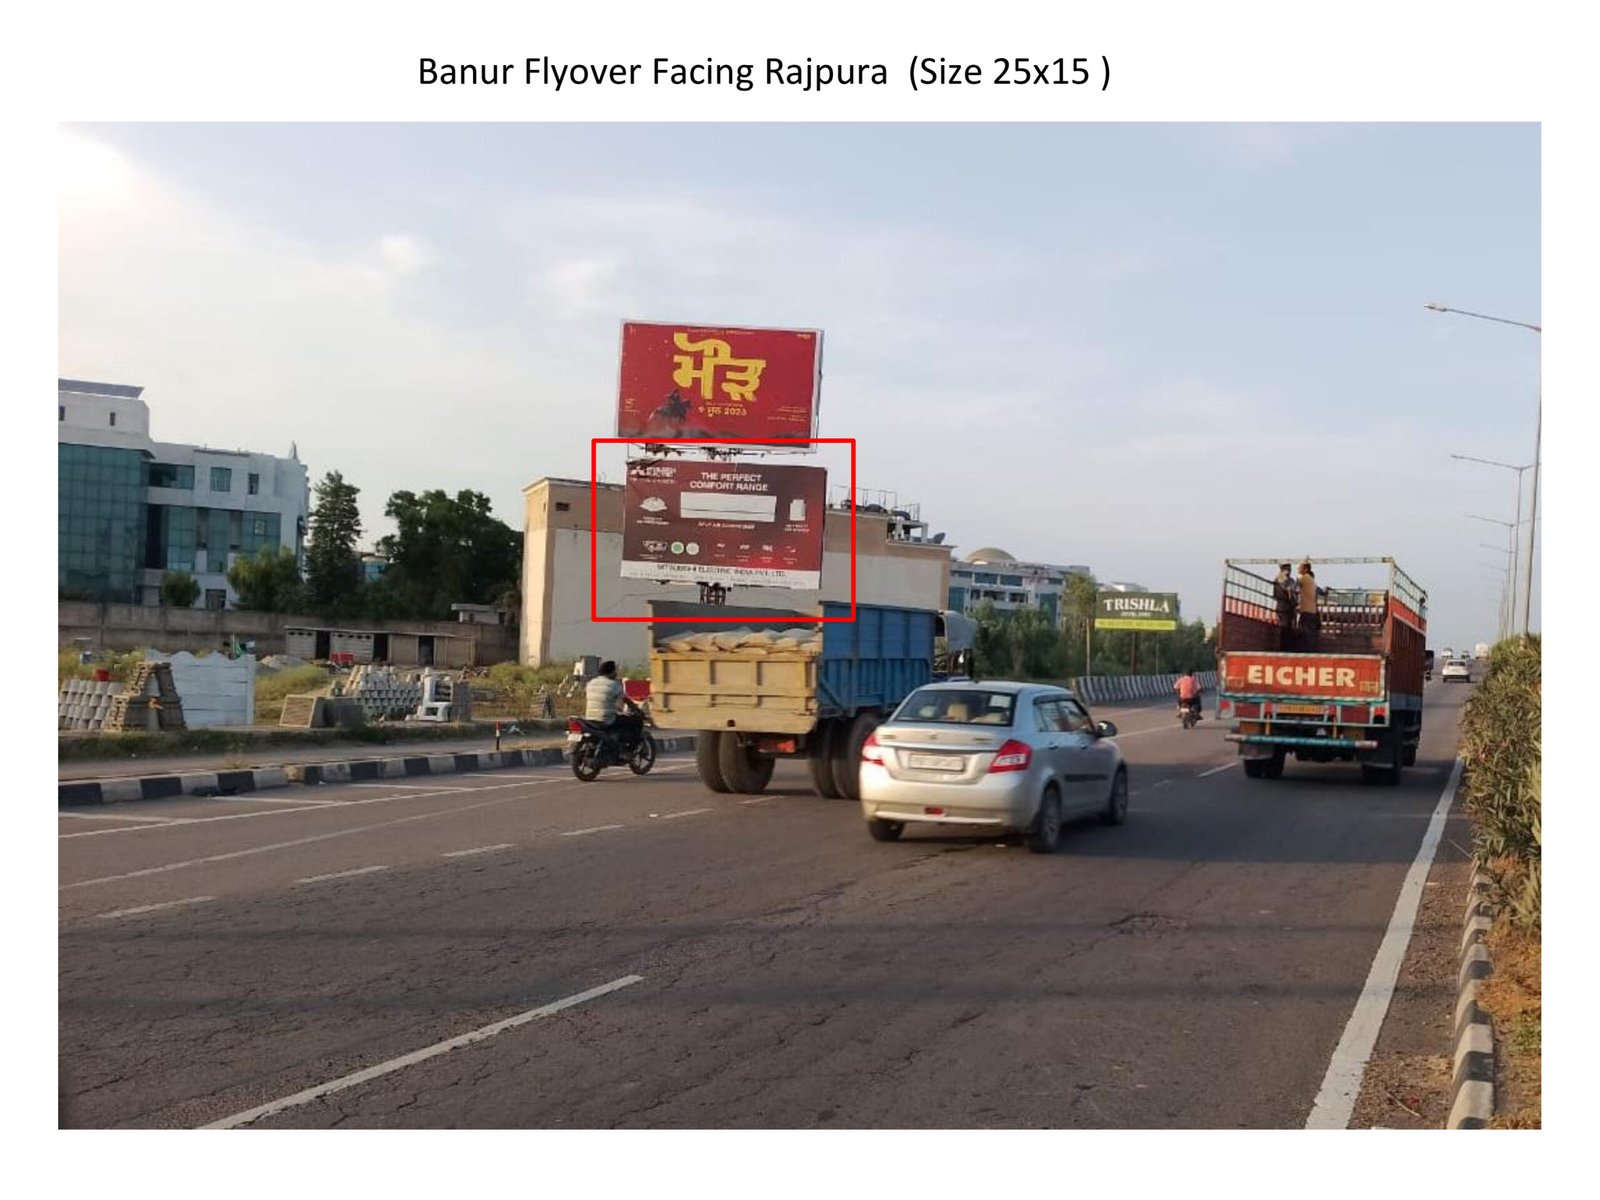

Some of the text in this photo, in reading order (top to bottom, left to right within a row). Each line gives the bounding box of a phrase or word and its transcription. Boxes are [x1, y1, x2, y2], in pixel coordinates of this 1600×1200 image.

[701, 472, 763, 482] THE PERFECT
[690, 480, 769, 491] COMFORT RANGE
[1103, 597, 1170, 614] TRISHLA
[1247, 665, 1355, 687] EICHER
